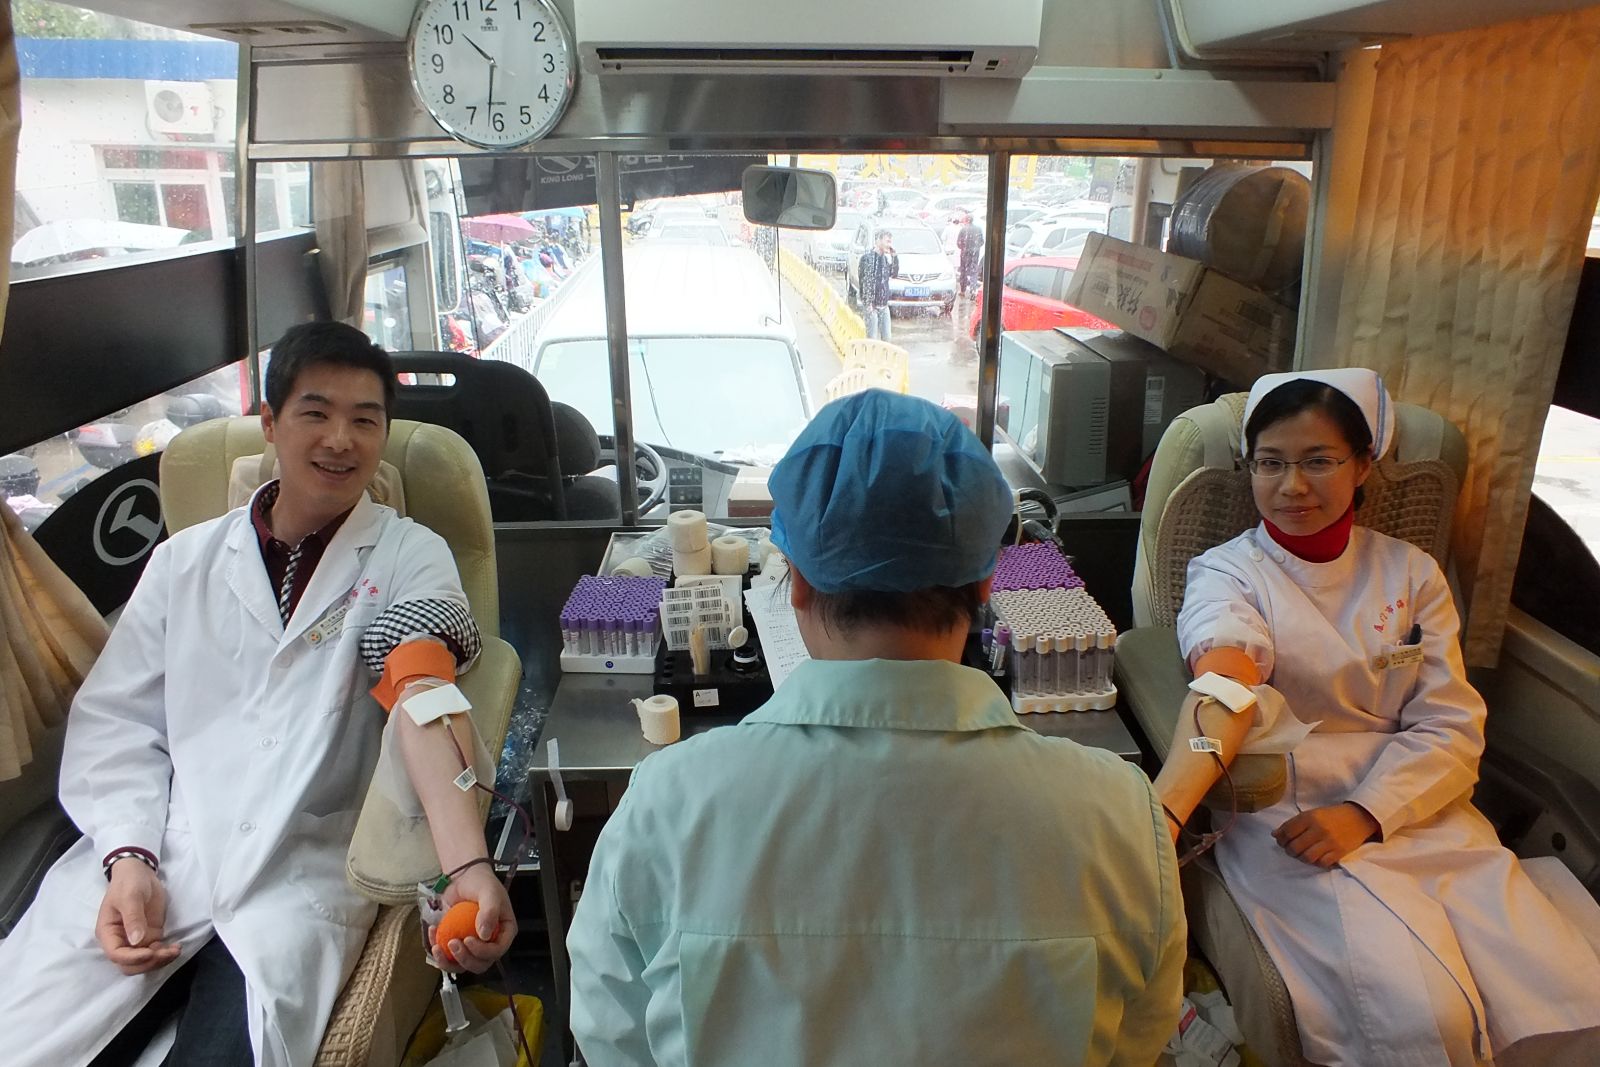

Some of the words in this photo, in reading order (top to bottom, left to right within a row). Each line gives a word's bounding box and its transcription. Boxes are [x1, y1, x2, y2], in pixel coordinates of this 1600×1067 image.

[453, 1, 470, 21] 11
[514, 1, 522, 20] 1
[434, 24, 454, 45] 10
[533, 22, 546, 42] 2
[432, 53, 444, 74] 9
[543, 53, 555, 73] 3
[443, 84, 455, 104] 8
[538, 84, 550, 103] 4
[466, 106, 477, 125] 7
[493, 113, 505, 132] 6
[520, 106, 532, 125] 5
[541, 176, 561, 184] KING
[562, 173, 584, 182] LONG
